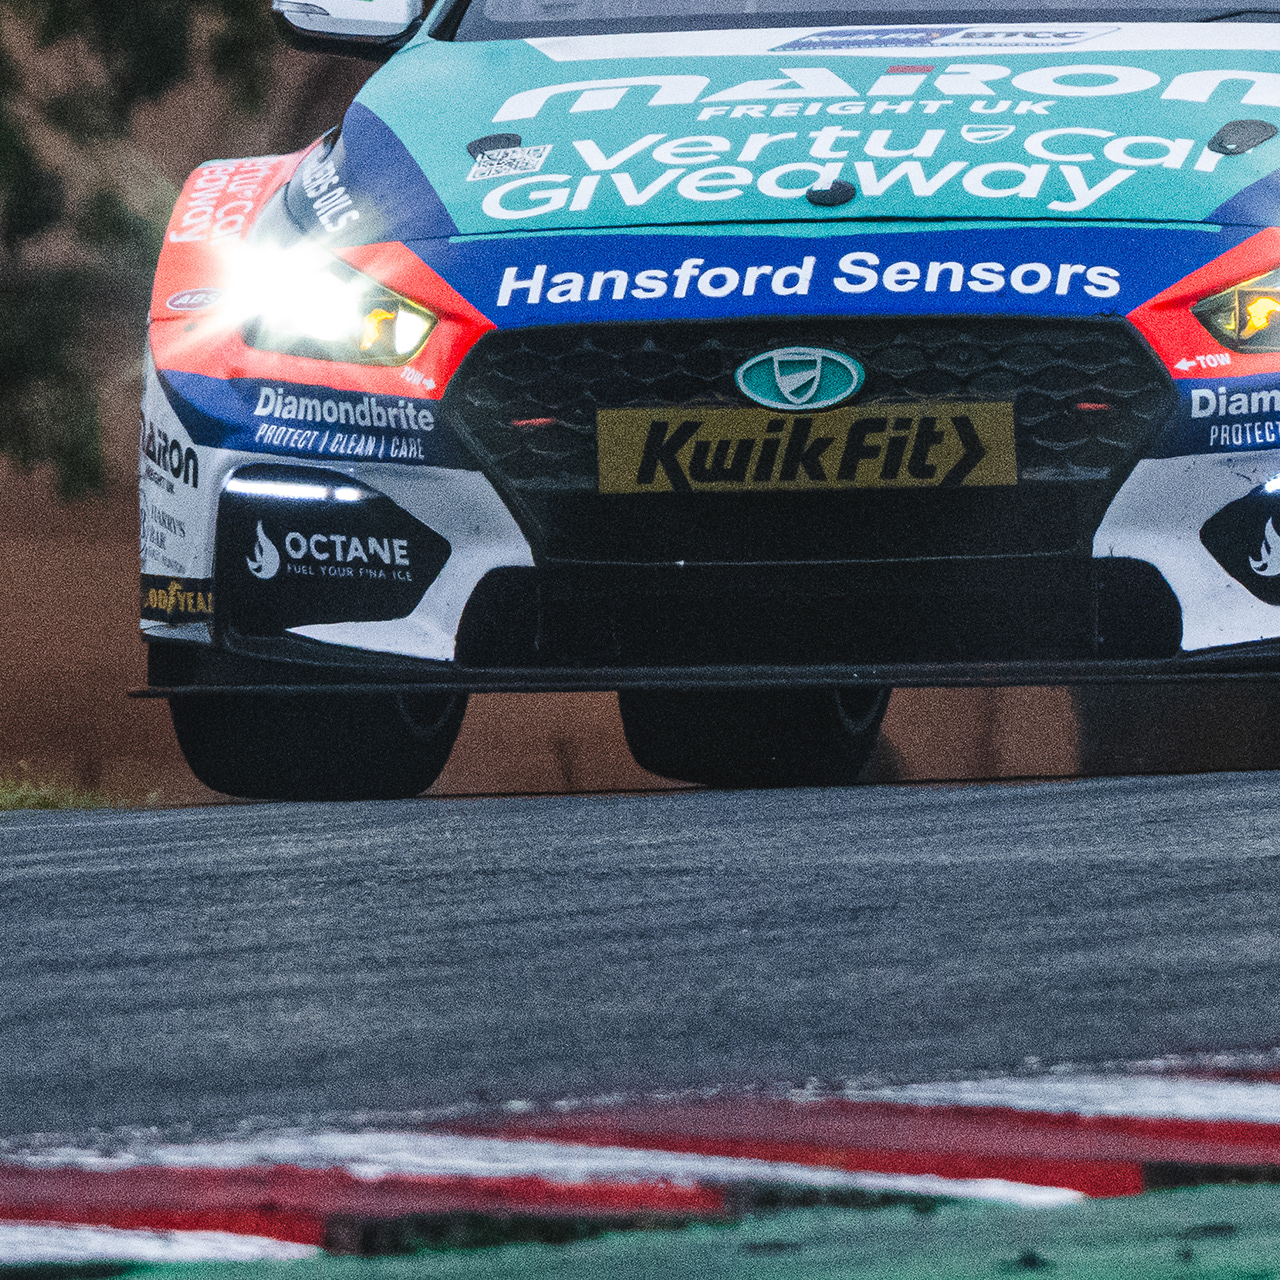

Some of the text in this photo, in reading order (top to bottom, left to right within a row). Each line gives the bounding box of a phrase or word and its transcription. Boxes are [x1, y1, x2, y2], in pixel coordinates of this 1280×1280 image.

[697, 99, 1058, 121] FREIGHT UK
[312, 186, 360, 233] OILS
[497, 251, 1120, 307] Hansford Sensors
[172, 293, 218, 305] ABS
[1196, 353, 1231, 369] TOW
[401, 366, 424, 386] TOW
[254, 387, 435, 432] Diamondbrite
[255, 423, 426, 460] PROTECT CLEAN CARE
[285, 531, 410, 566] OCTANE
[287, 563, 315, 576] FUEL
[320, 565, 354, 578] YOUR
